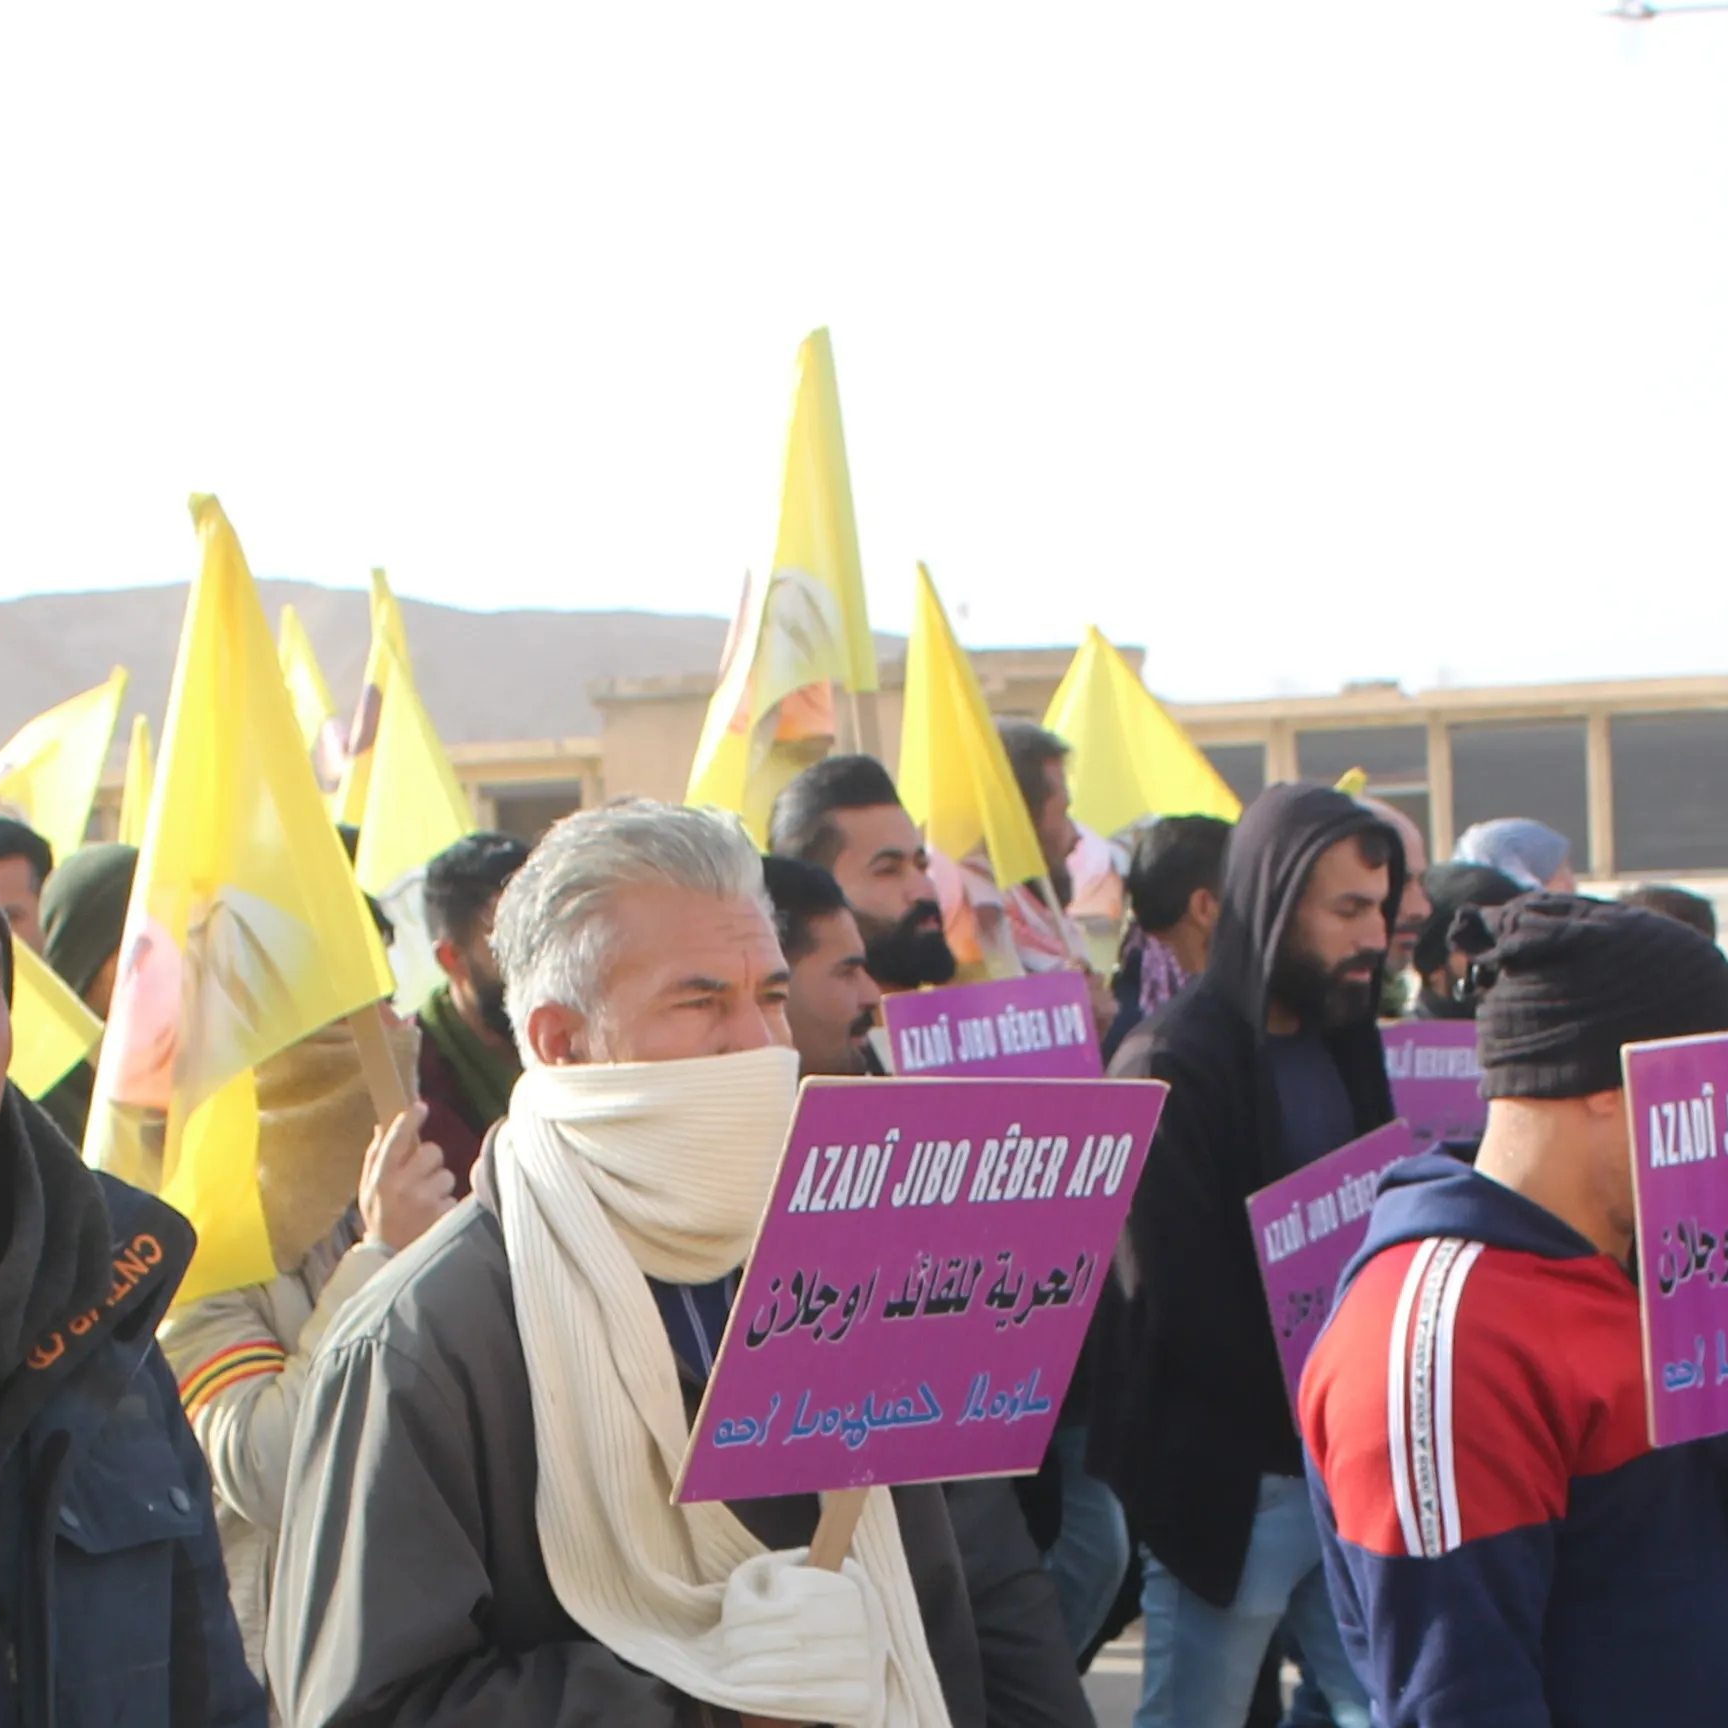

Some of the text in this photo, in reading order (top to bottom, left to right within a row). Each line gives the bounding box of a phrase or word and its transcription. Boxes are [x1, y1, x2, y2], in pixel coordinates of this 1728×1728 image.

[899, 1013, 953, 1071] AZADÎ
[787, 1122, 1134, 1214] AZADÎ JIBO RÊBER APO
[1649, 1081, 1718, 1168] AZADÎ
[744, 1250, 1099, 1351] الحرية للقائد اوجلان
